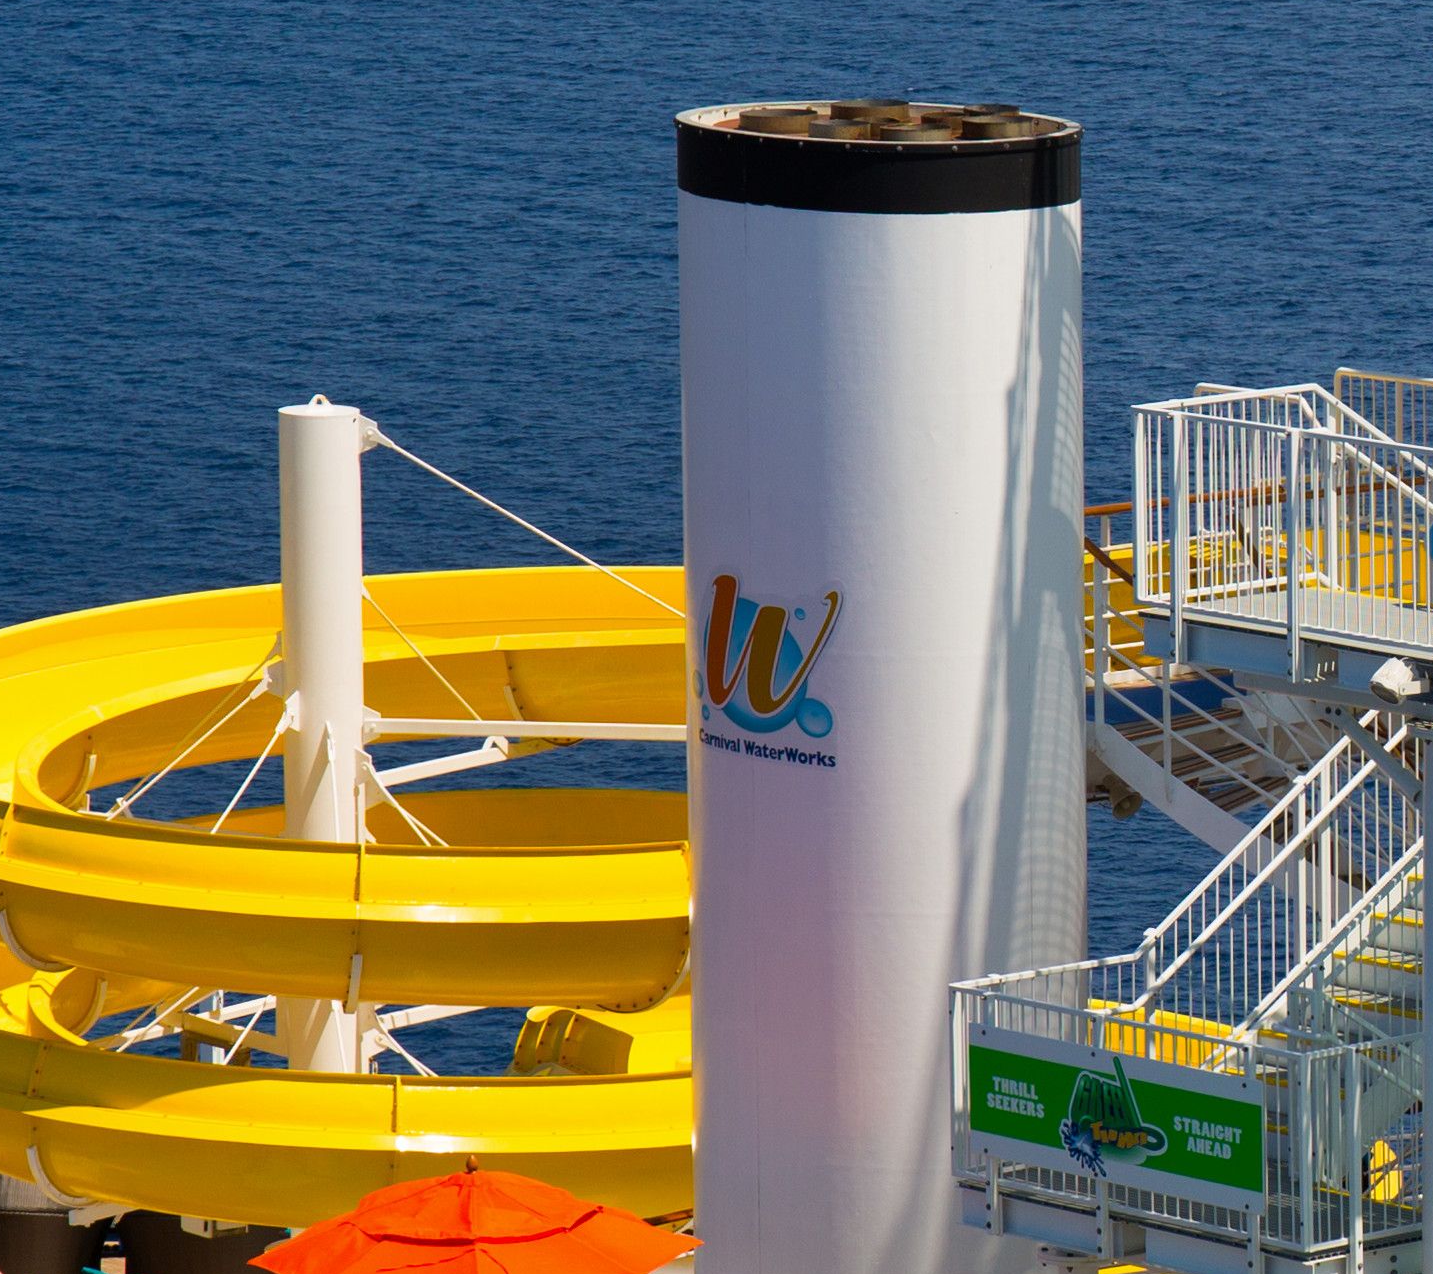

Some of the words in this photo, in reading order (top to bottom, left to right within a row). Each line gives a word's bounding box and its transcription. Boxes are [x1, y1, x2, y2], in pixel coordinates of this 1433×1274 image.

[699, 728, 741, 753] Carnival
[743, 740, 837, 768] WaterWorks
[992, 1076, 1039, 1100] THRILL
[986, 1092, 1045, 1119] SEEKERS
[1173, 1115, 1243, 1144] STRAIGHT
[1187, 1136, 1232, 1160] AHEAD
